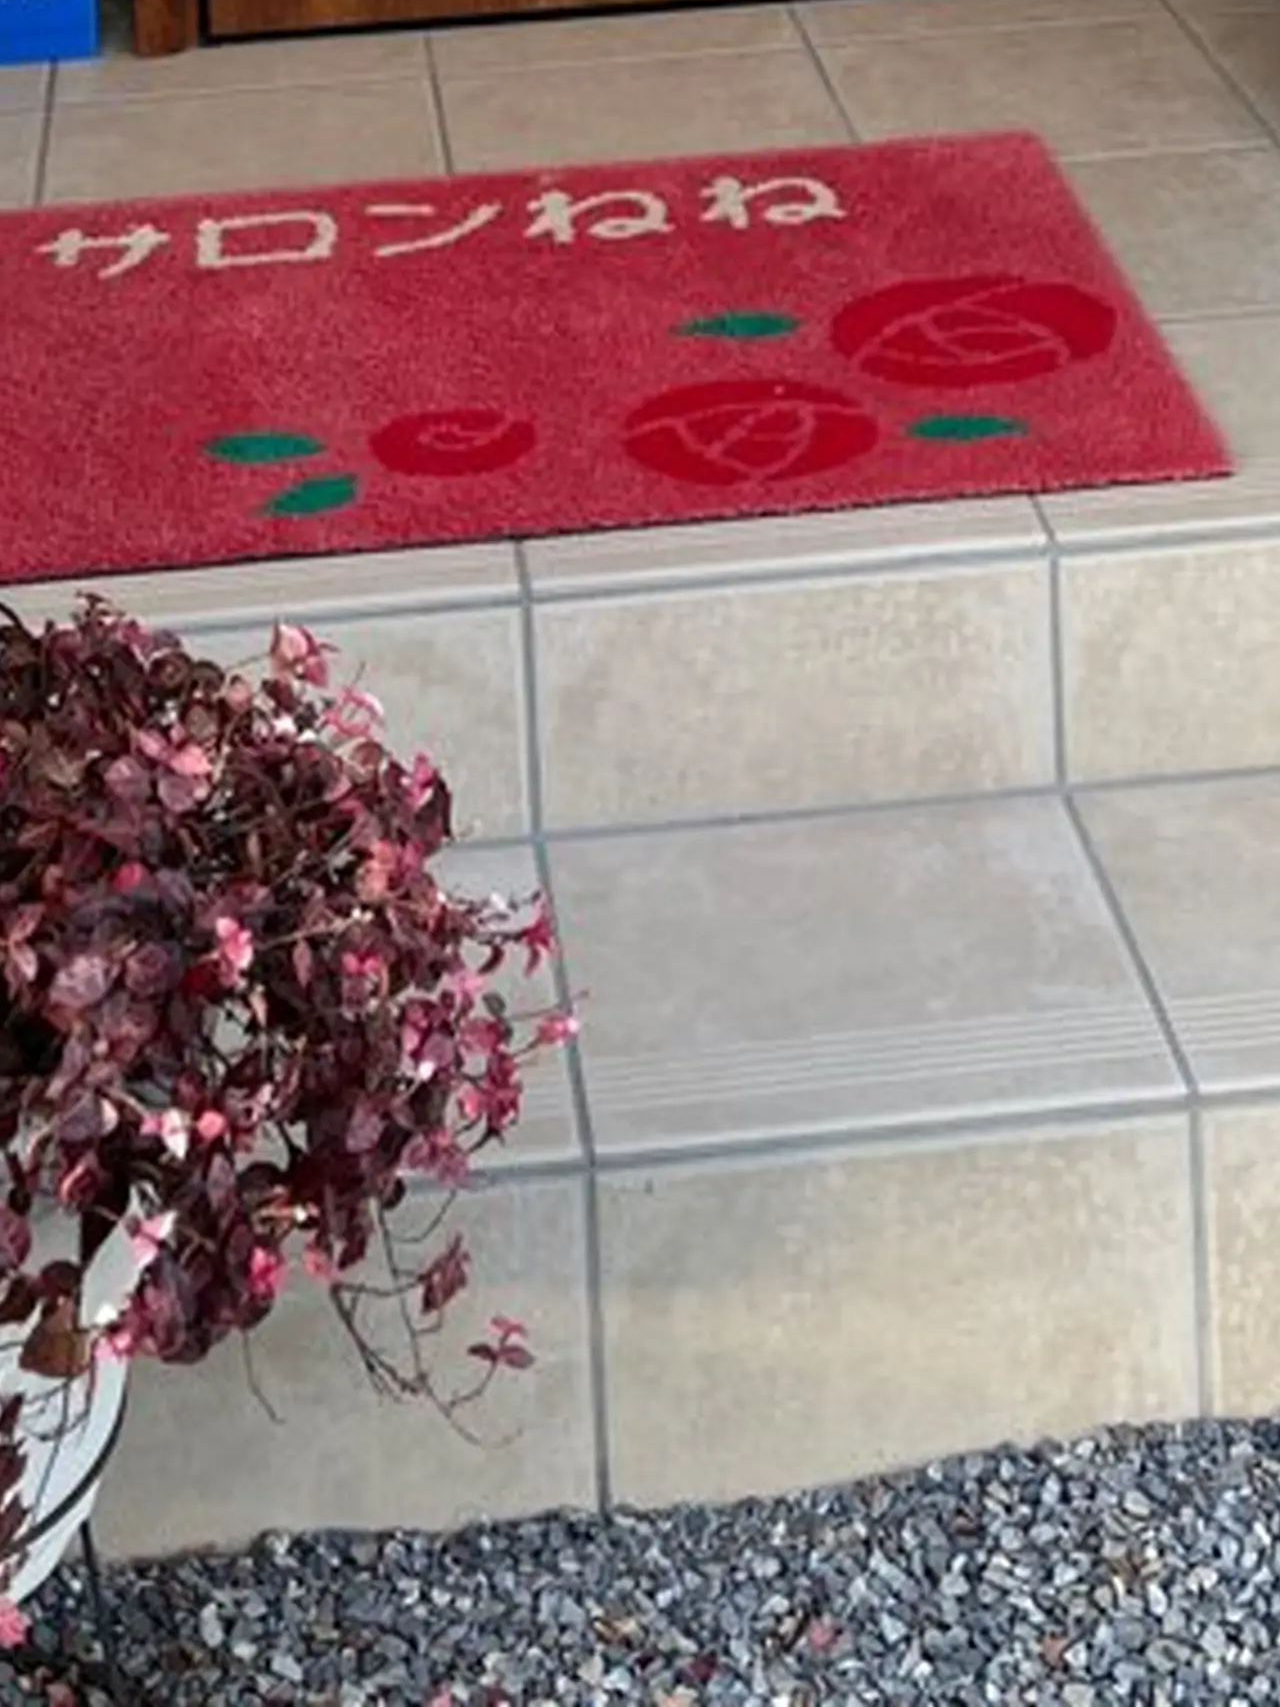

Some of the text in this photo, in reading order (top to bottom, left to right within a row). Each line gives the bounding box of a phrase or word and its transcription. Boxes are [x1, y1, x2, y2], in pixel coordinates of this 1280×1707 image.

[35, 175, 846, 280] サロンねね
